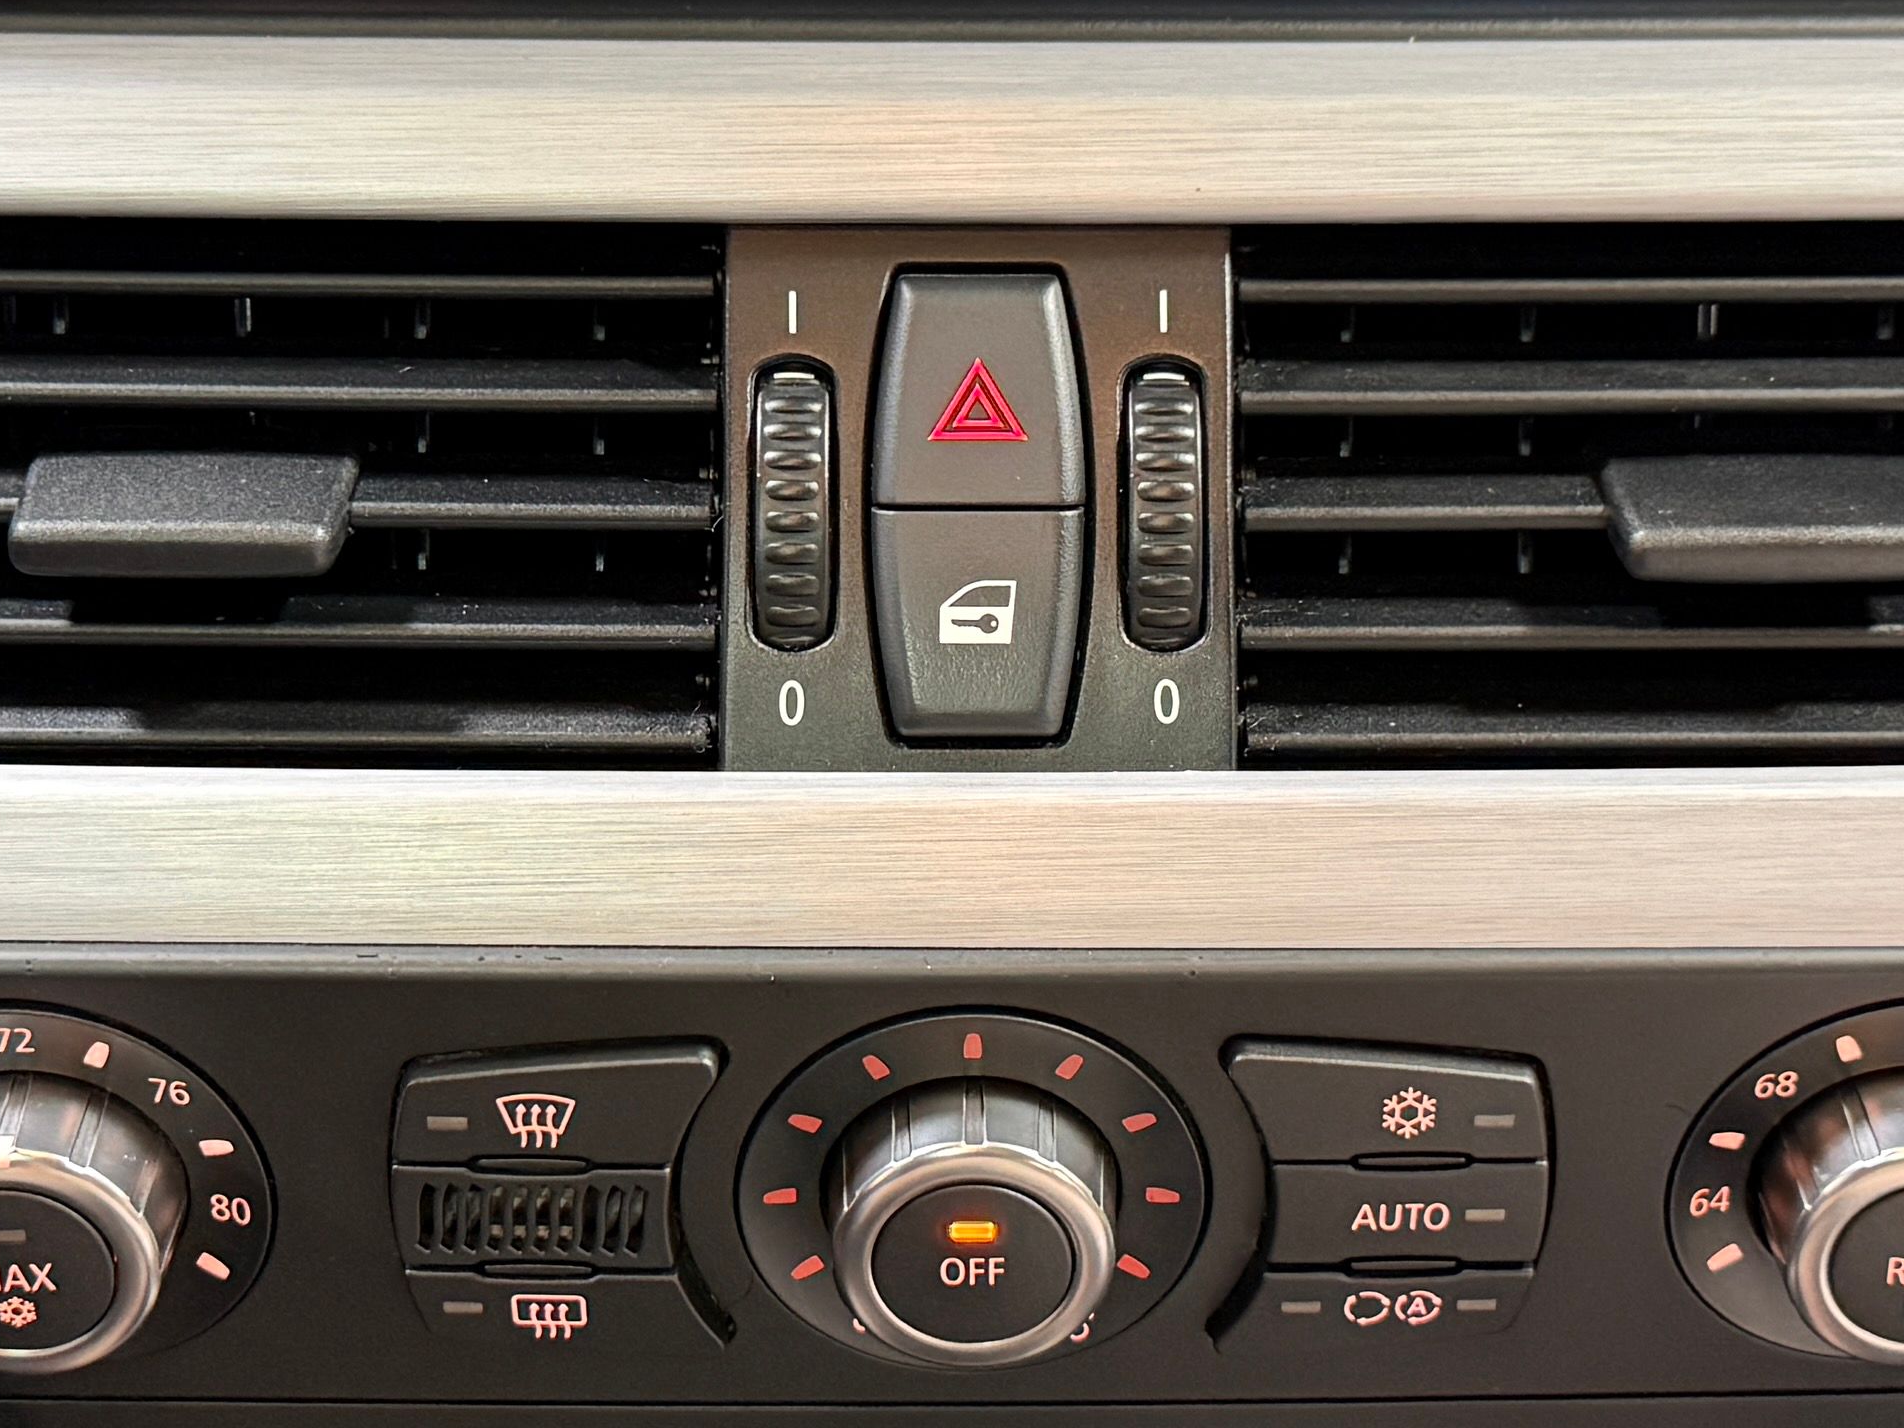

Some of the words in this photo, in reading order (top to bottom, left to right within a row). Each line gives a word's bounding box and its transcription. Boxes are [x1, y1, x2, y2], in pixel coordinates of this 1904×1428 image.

[148, 1077, 191, 1107] 76
[1754, 1071, 1799, 1099] 68
[209, 1193, 251, 1226] 80
[1689, 1186, 1731, 1217] 64
[1351, 1202, 1451, 1232] AUTO
[939, 1257, 1005, 1286] OFF
